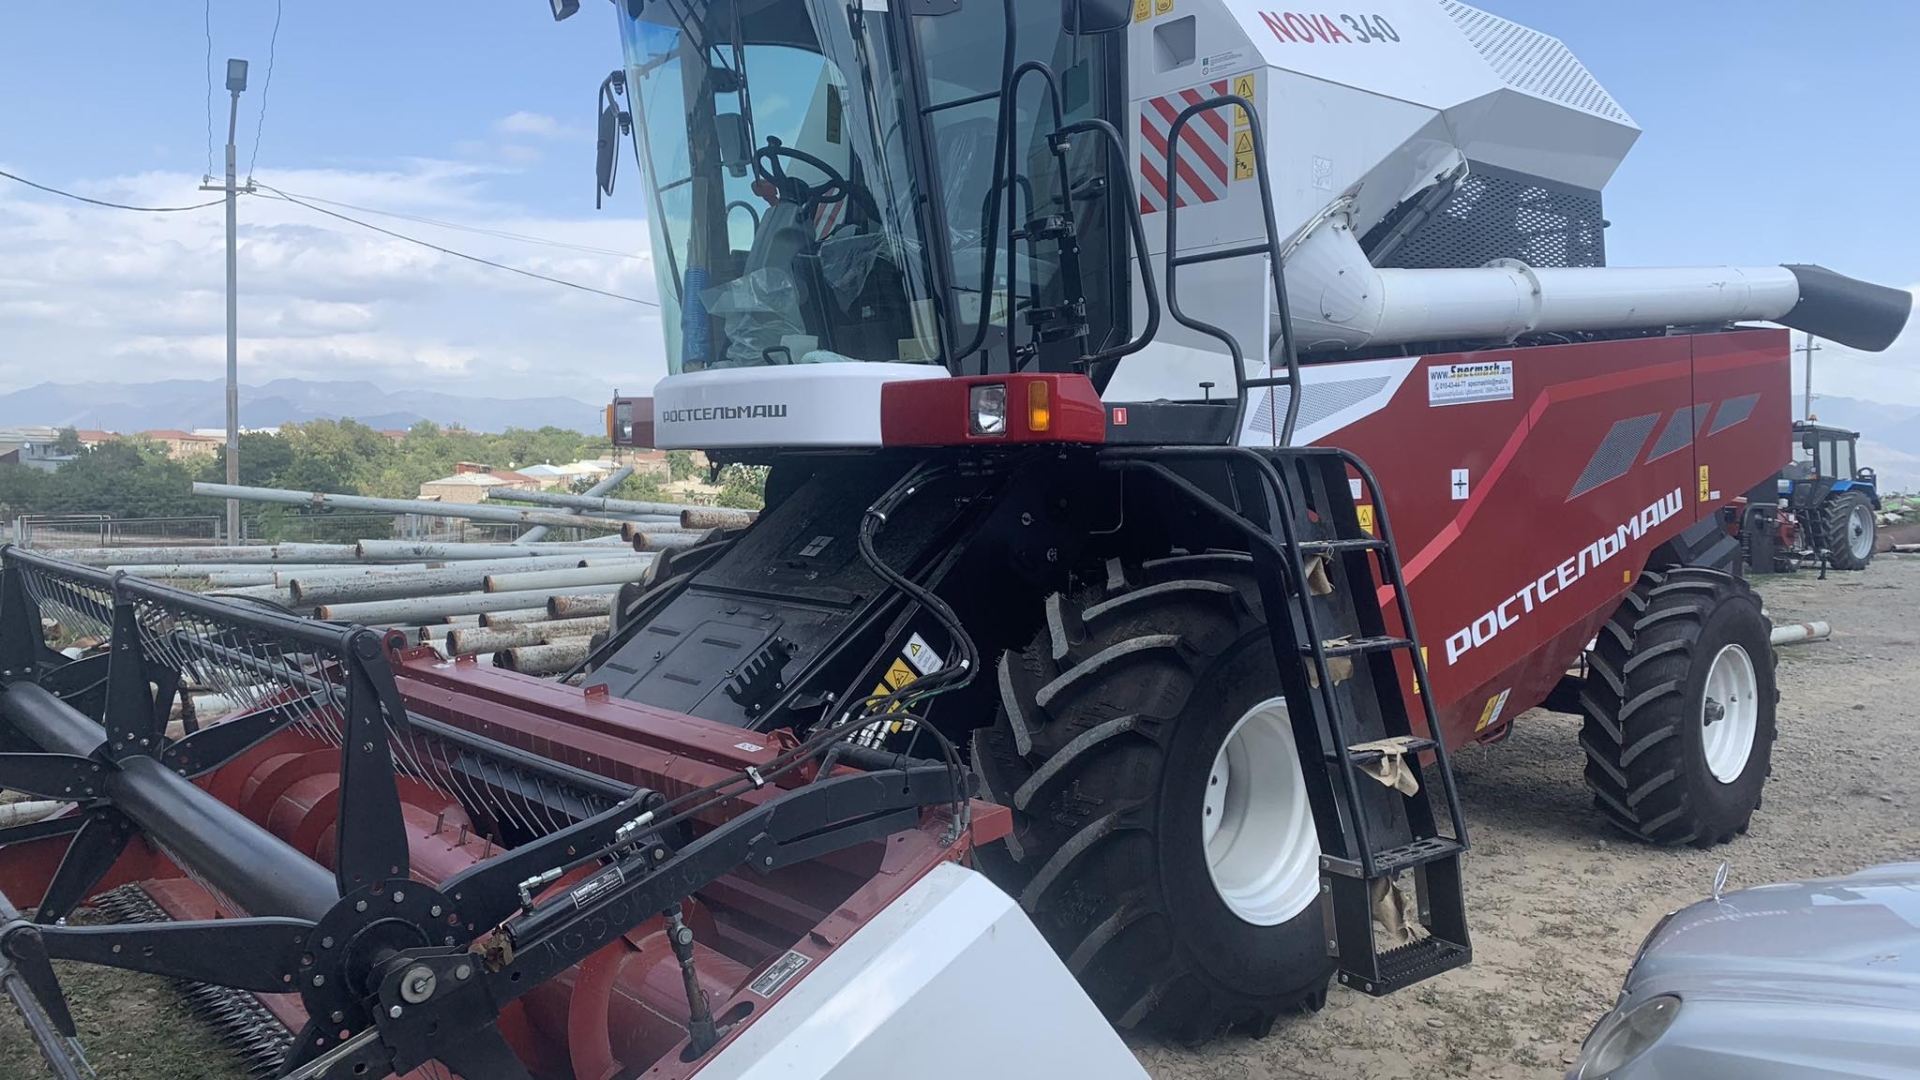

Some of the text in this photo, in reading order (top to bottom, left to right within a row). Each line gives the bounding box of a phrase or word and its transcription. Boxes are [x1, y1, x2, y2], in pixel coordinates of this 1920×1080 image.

[1258, 11, 1400, 43] NOVA 340
[662, 404, 787, 423] РОСТСЕЛЬМАШ
[1445, 487, 1683, 666] РОСТСЕЛЬМАШ
